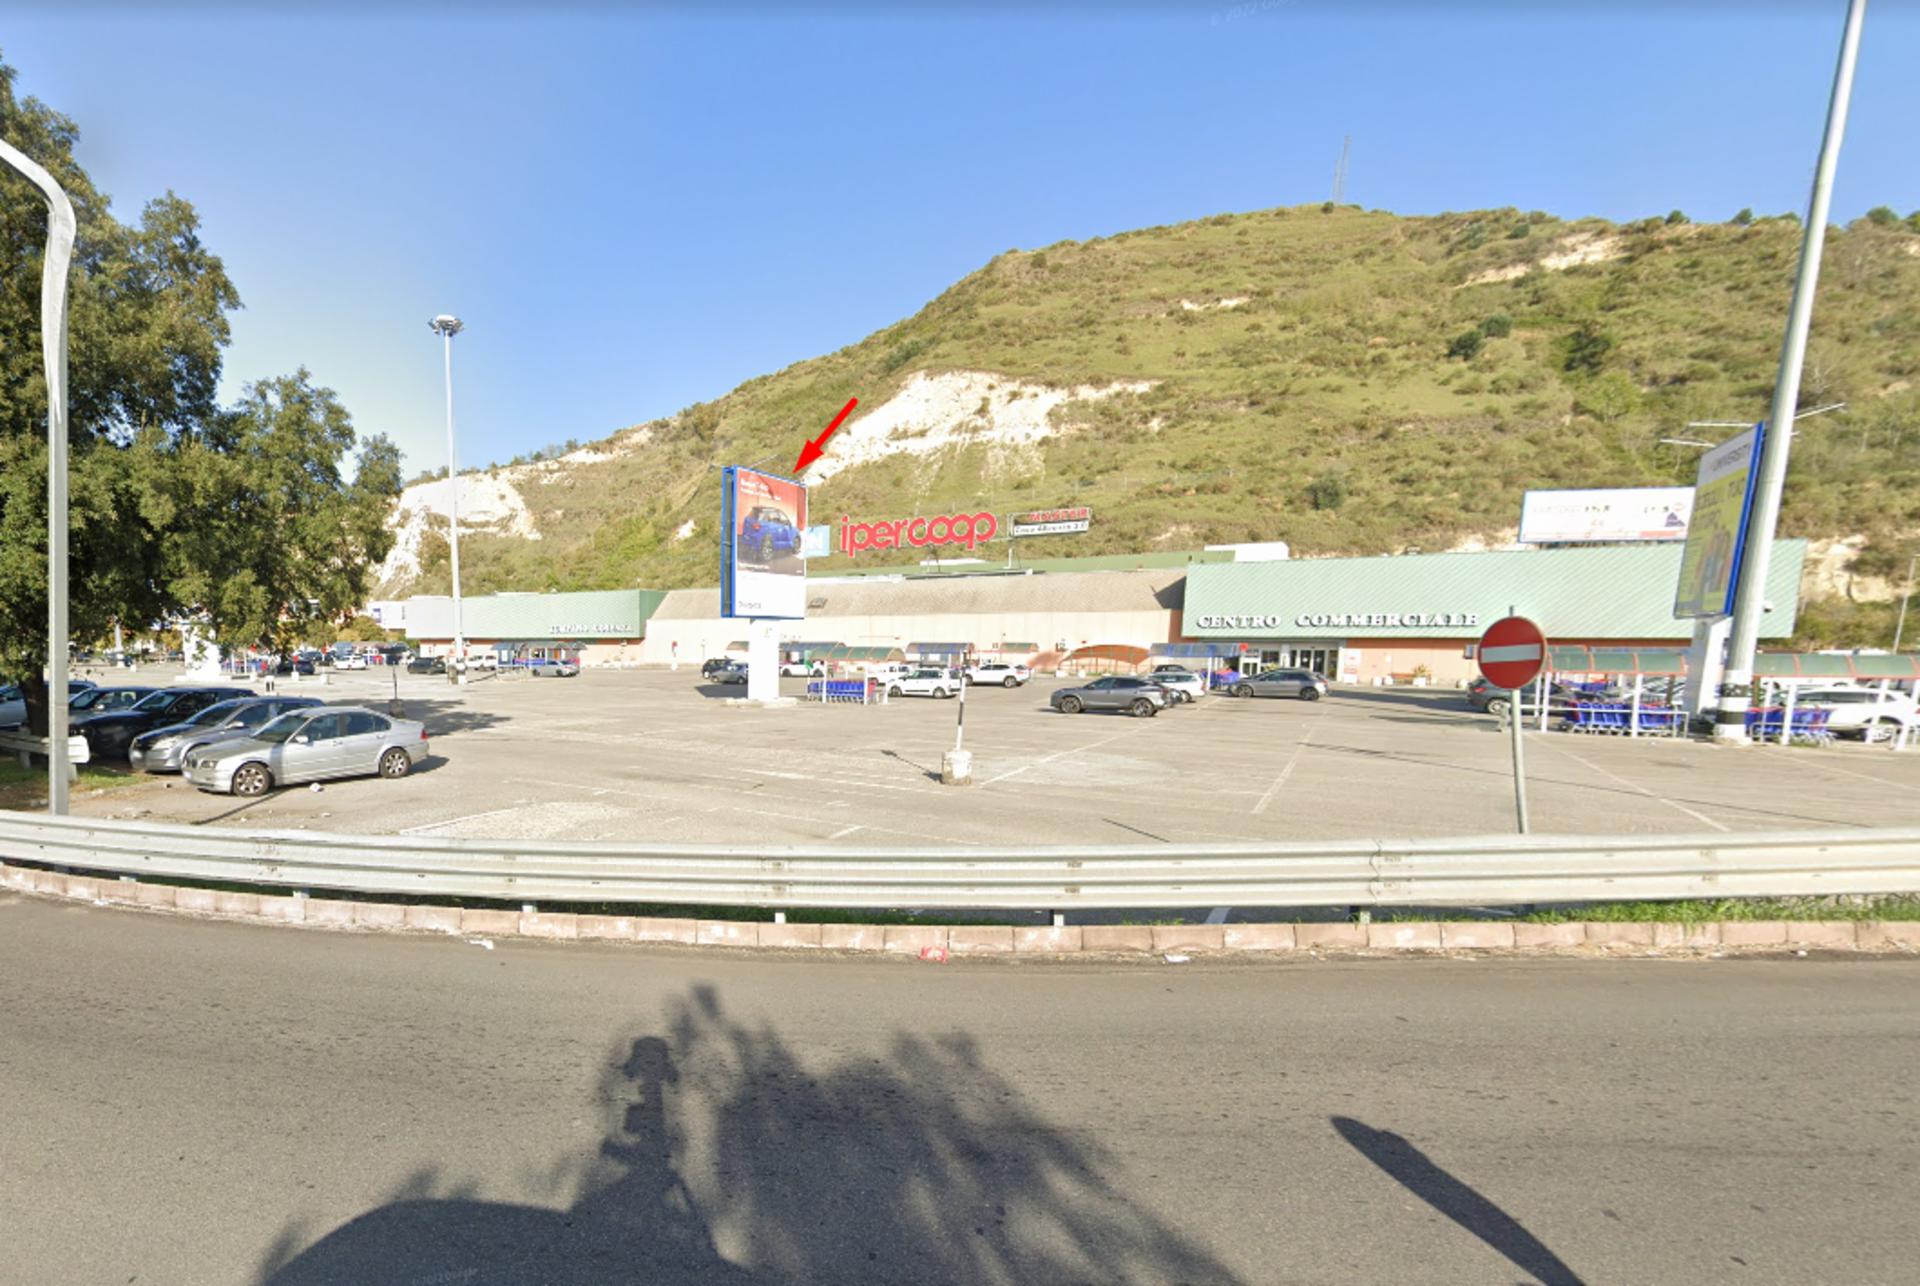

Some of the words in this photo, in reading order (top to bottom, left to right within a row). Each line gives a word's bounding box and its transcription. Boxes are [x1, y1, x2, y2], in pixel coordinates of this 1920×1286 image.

[840, 511, 997, 558] ipercoop
[1196, 614, 1281, 628] CENTRO
[1294, 612, 1479, 627] COMMERCIALE
